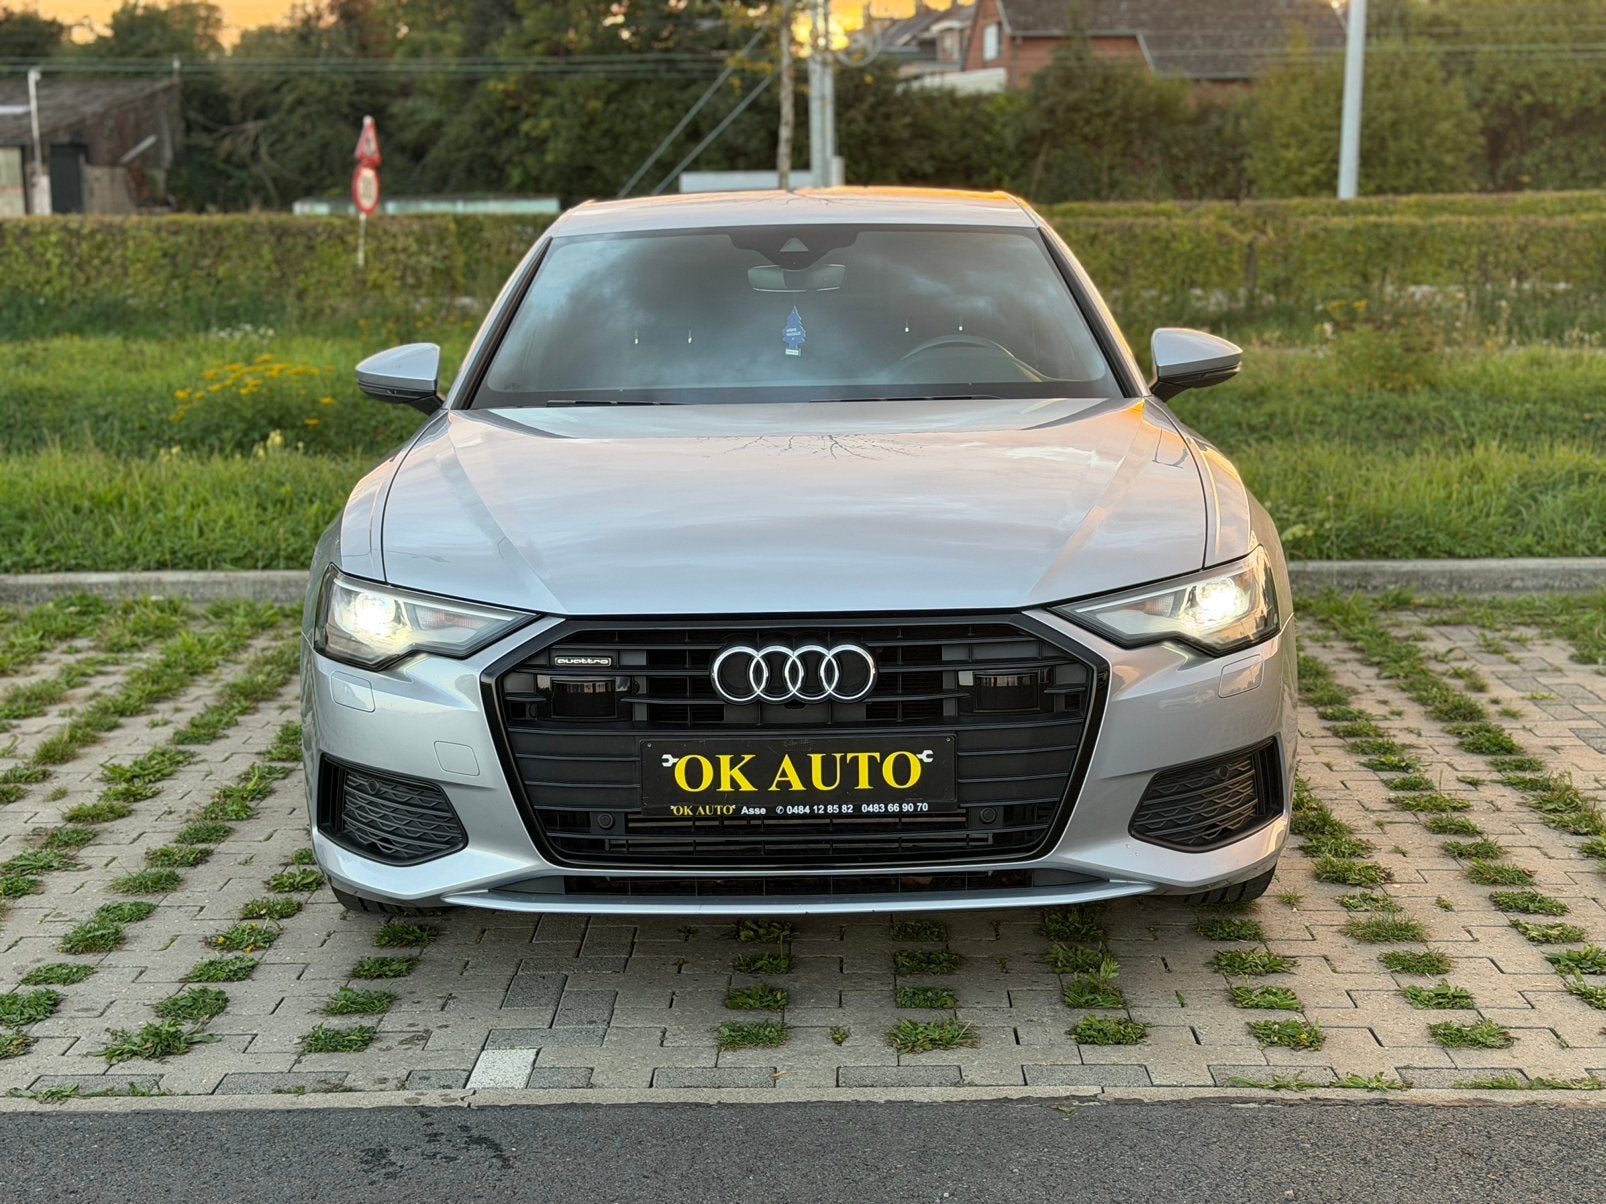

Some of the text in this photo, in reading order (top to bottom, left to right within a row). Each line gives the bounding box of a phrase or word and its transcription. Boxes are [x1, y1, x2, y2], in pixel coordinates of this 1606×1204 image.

[674, 751, 922, 792] OK AUTO
[672, 802, 929, 816] OK AUTO Asse 0484 12 85 82 0483 66 90 70
